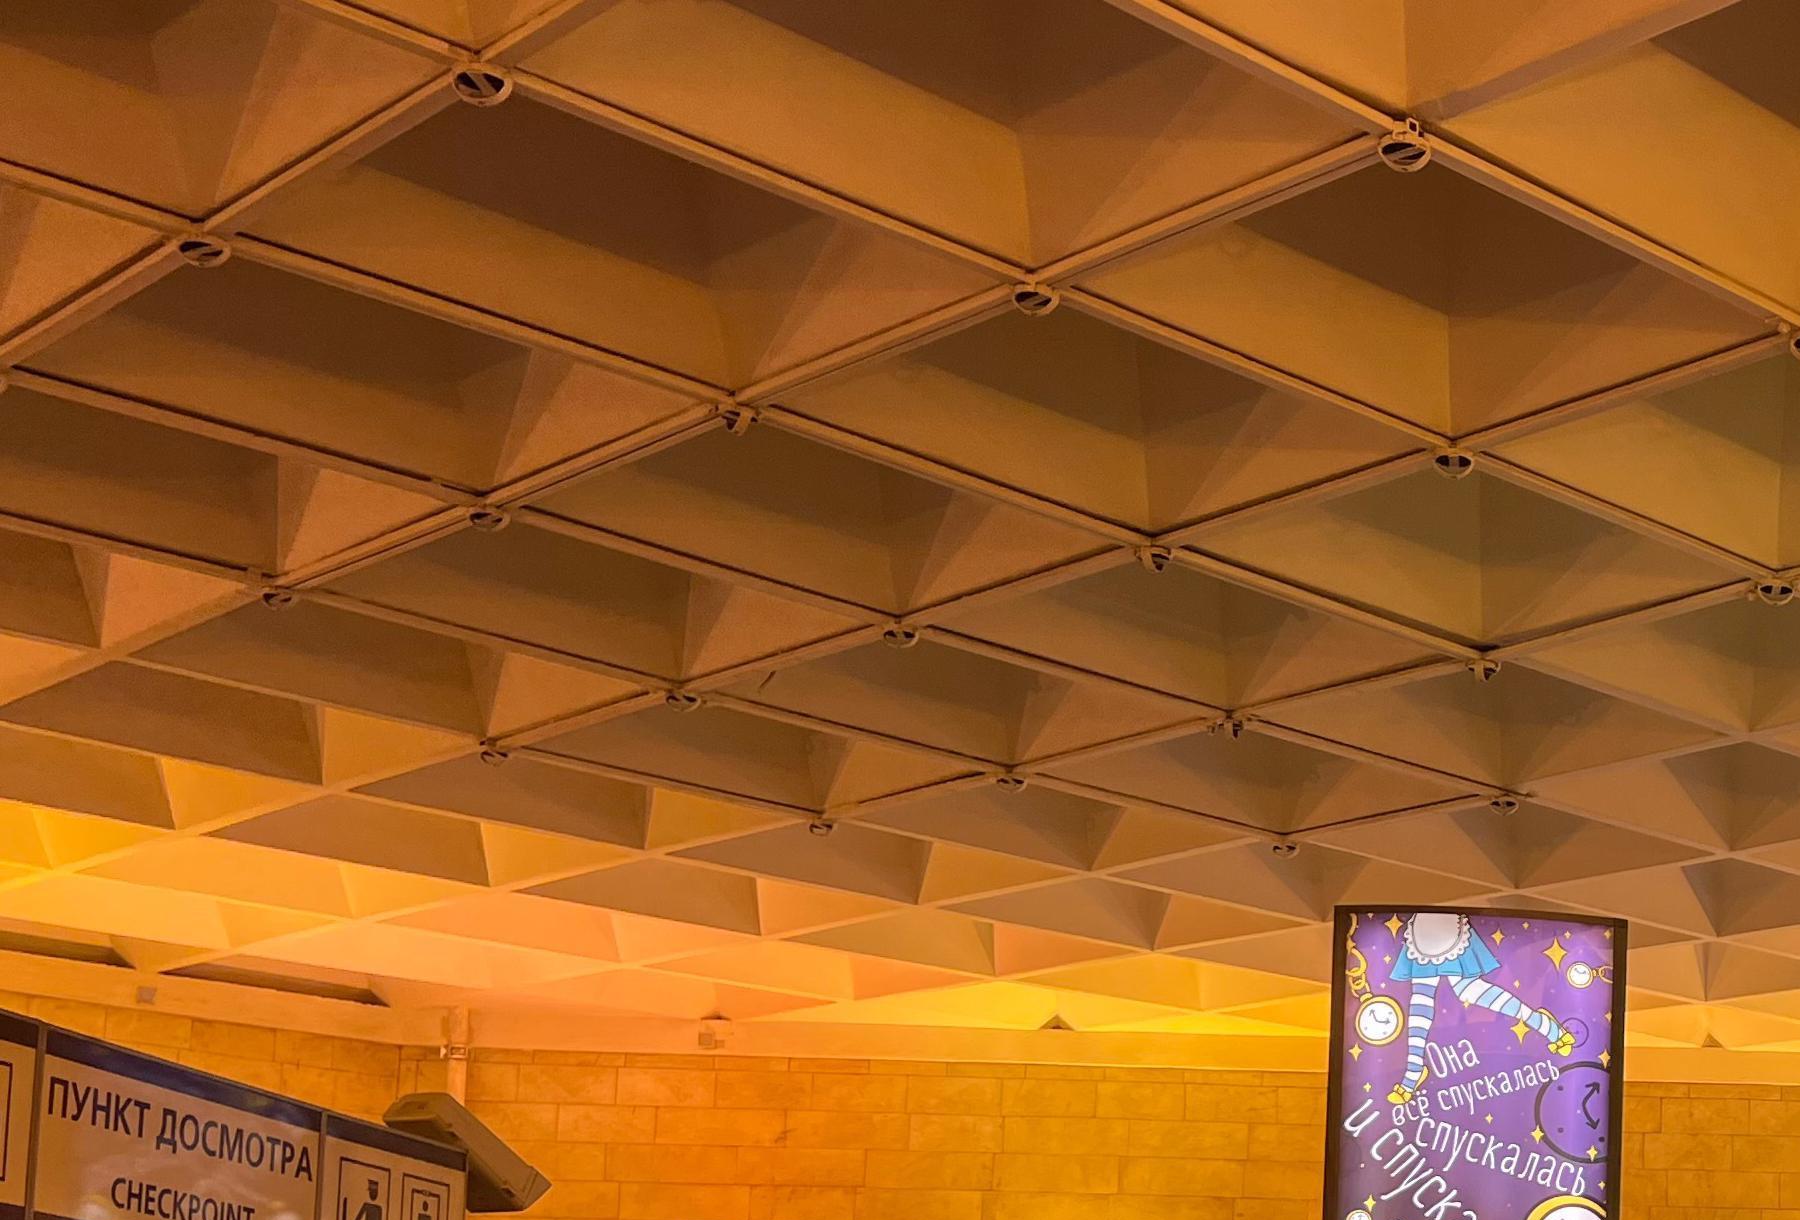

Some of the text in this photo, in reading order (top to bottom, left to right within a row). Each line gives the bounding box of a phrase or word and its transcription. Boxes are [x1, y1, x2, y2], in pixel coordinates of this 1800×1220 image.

[1392, 1059, 1561, 1126] всё спускалась
[1424, 1039, 1480, 1079] Она
[48, 1077, 313, 1182] ПУНКТ ДОСМОТРА
[1415, 1116, 1588, 1196] спускалась
